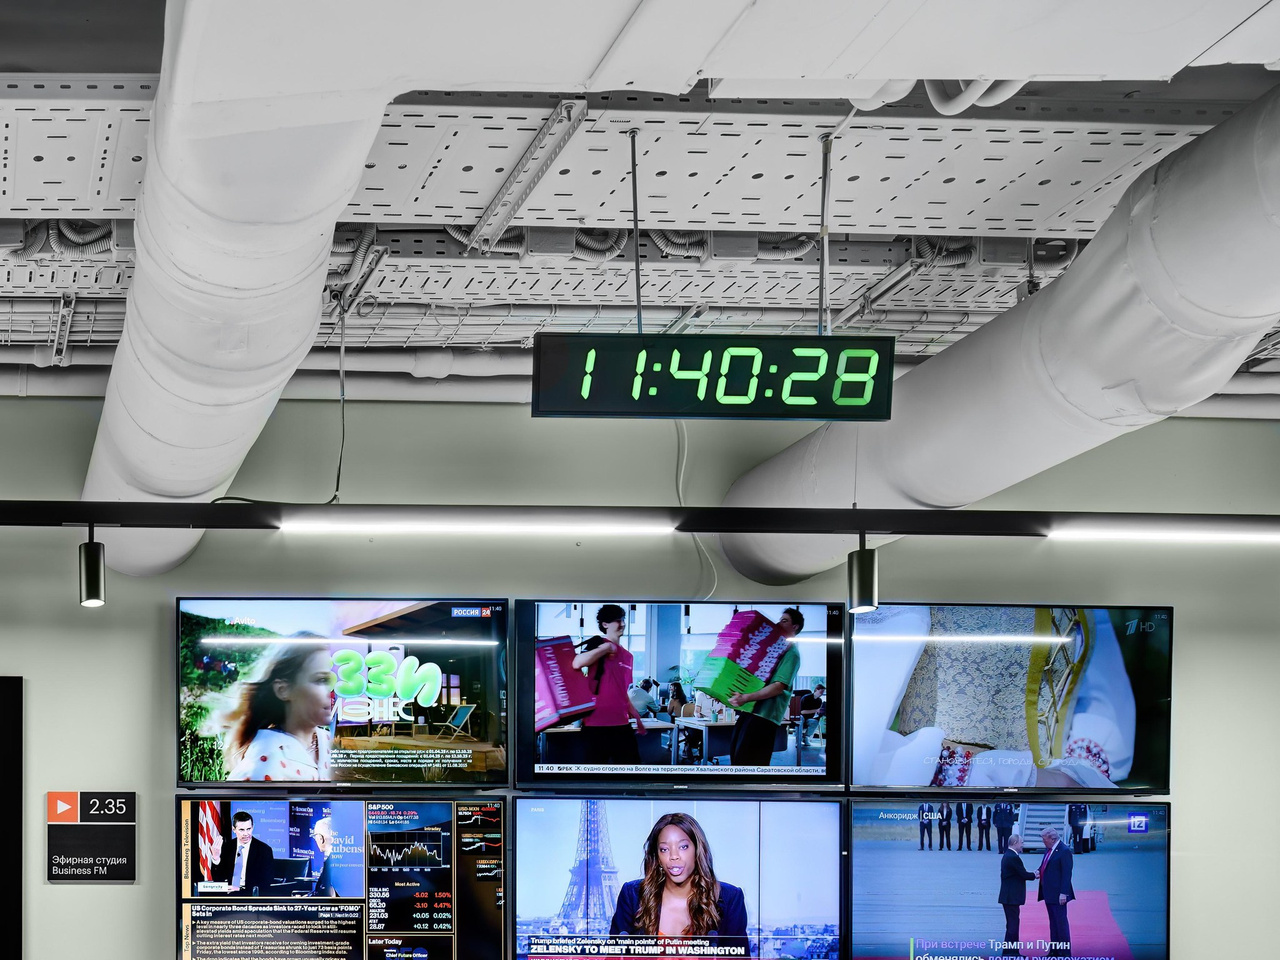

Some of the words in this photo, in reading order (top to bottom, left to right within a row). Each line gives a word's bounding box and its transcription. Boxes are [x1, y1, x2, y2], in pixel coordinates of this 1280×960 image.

[580, 347, 880, 406] 11:40:28
[234, 616, 256, 624] Avito
[1140, 622, 1155, 632] HD
[89, 798, 126, 814] 2.35
[879, 812, 918, 820] Анкоридж
[52, 855, 93, 865] Эфирная
[96, 857, 127, 865] студия
[52, 866, 91, 874] Business
[94, 866, 107, 874] FM
[916, 939, 938, 951] При
[941, 941, 986, 951] встрече
[988, 939, 1023, 951] Трамп
[1036, 940, 1070, 952] Путин
